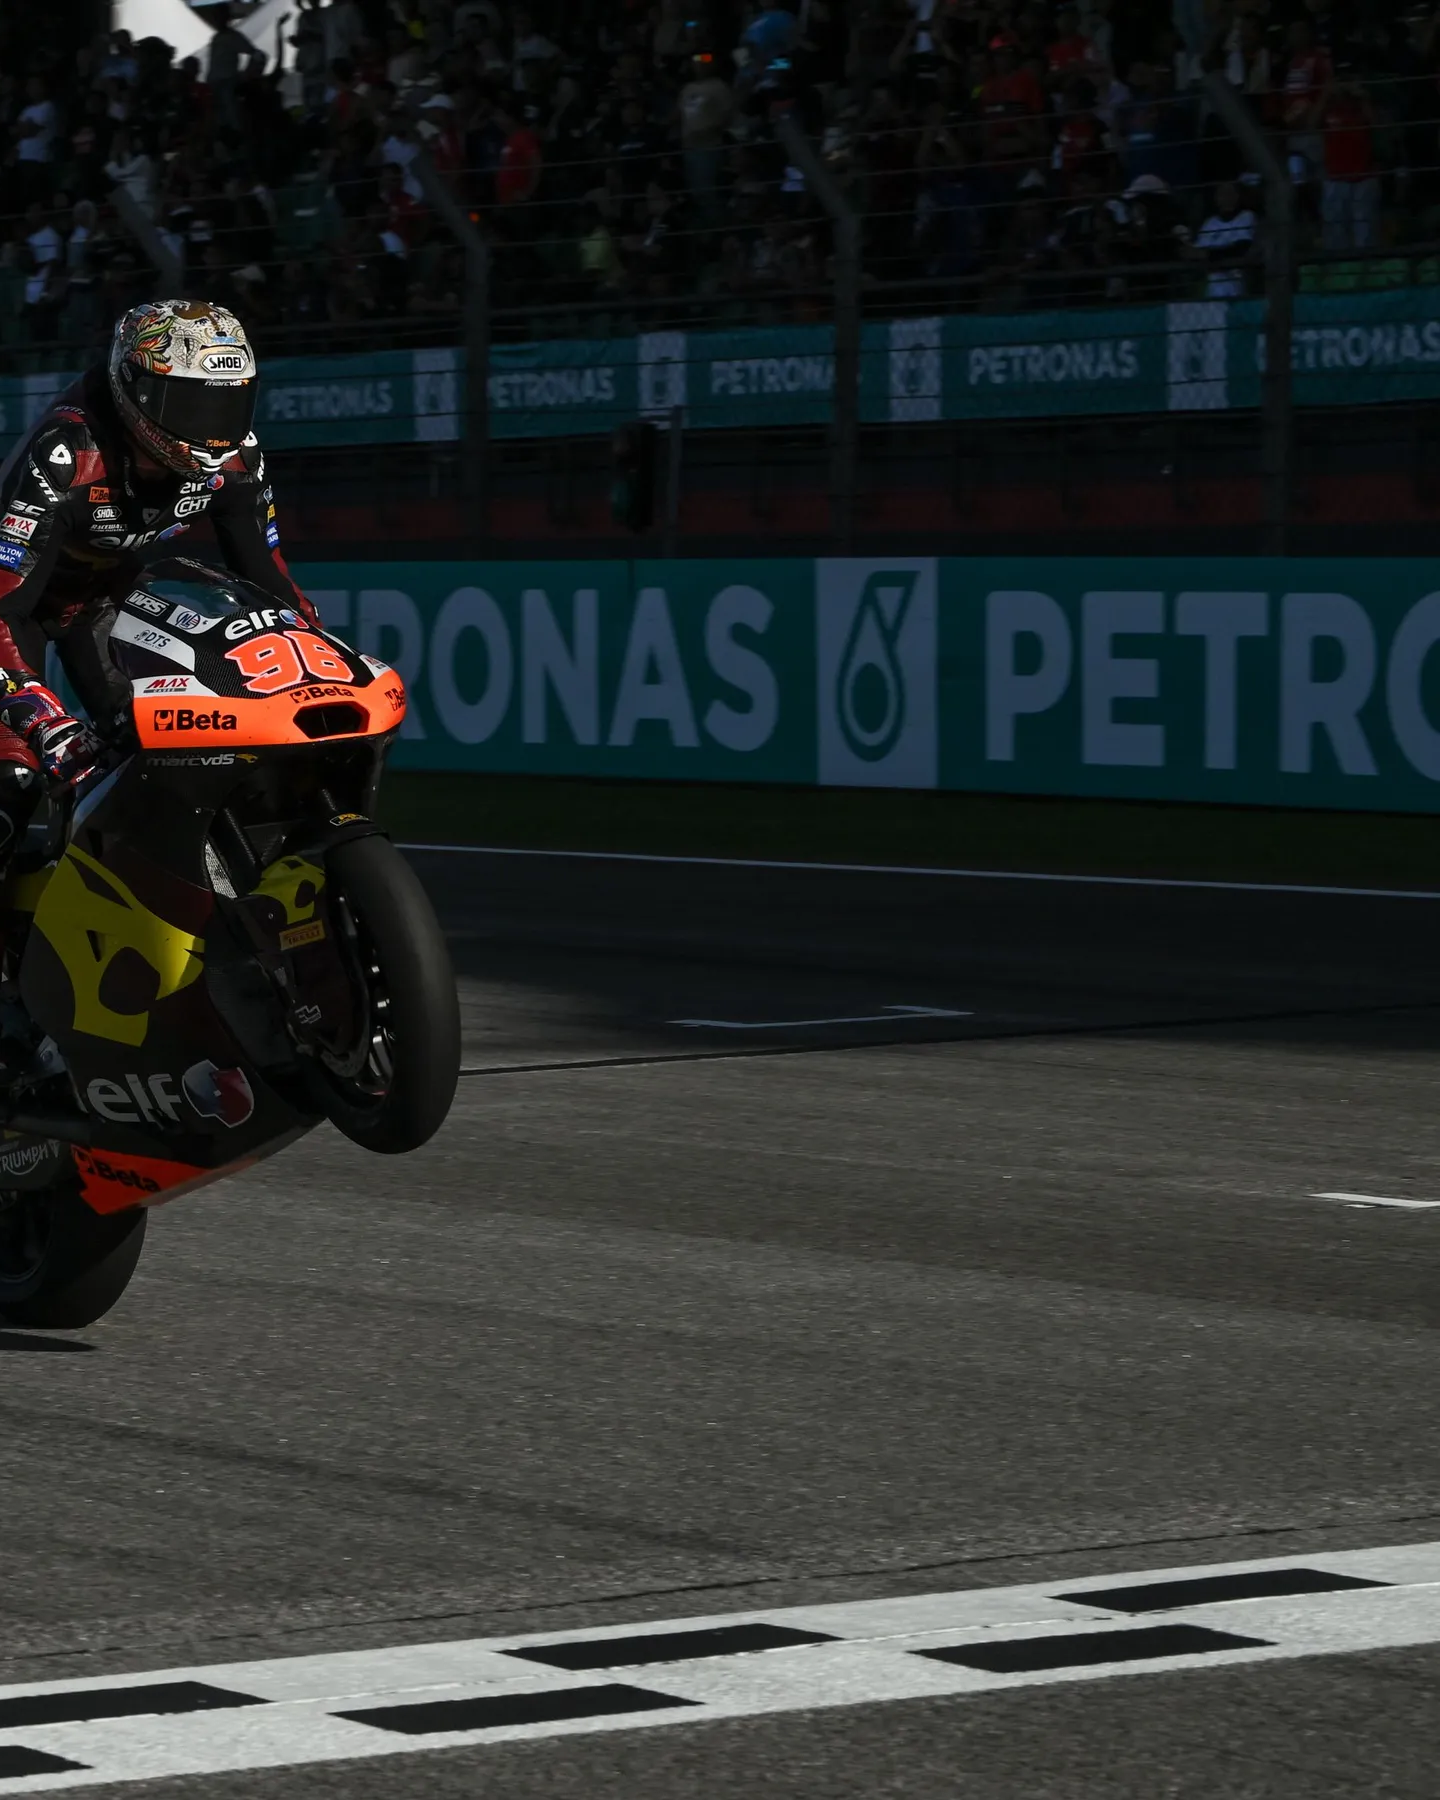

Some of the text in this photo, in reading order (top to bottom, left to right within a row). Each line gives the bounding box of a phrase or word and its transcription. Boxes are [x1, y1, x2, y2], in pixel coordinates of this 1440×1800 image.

[209, 356, 242, 369] SHOEI
[968, 339, 1140, 386] PETRONAS
[711, 354, 863, 395] PETRONA
[267, 381, 394, 420] PETRONAS
[10, 500, 47, 518] SC
[2, 515, 34, 533] MAX
[128, 591, 167, 614] WRS
[224, 609, 280, 641] elf
[145, 631, 171, 648] DTS
[224, 630, 355, 695] 96
[145, 677, 190, 690] MAX
[309, 686, 355, 699] Beta
[176, 709, 237, 731] Beta
[86, 1073, 183, 1124] elf
[93, 1159, 161, 1193] Beta
